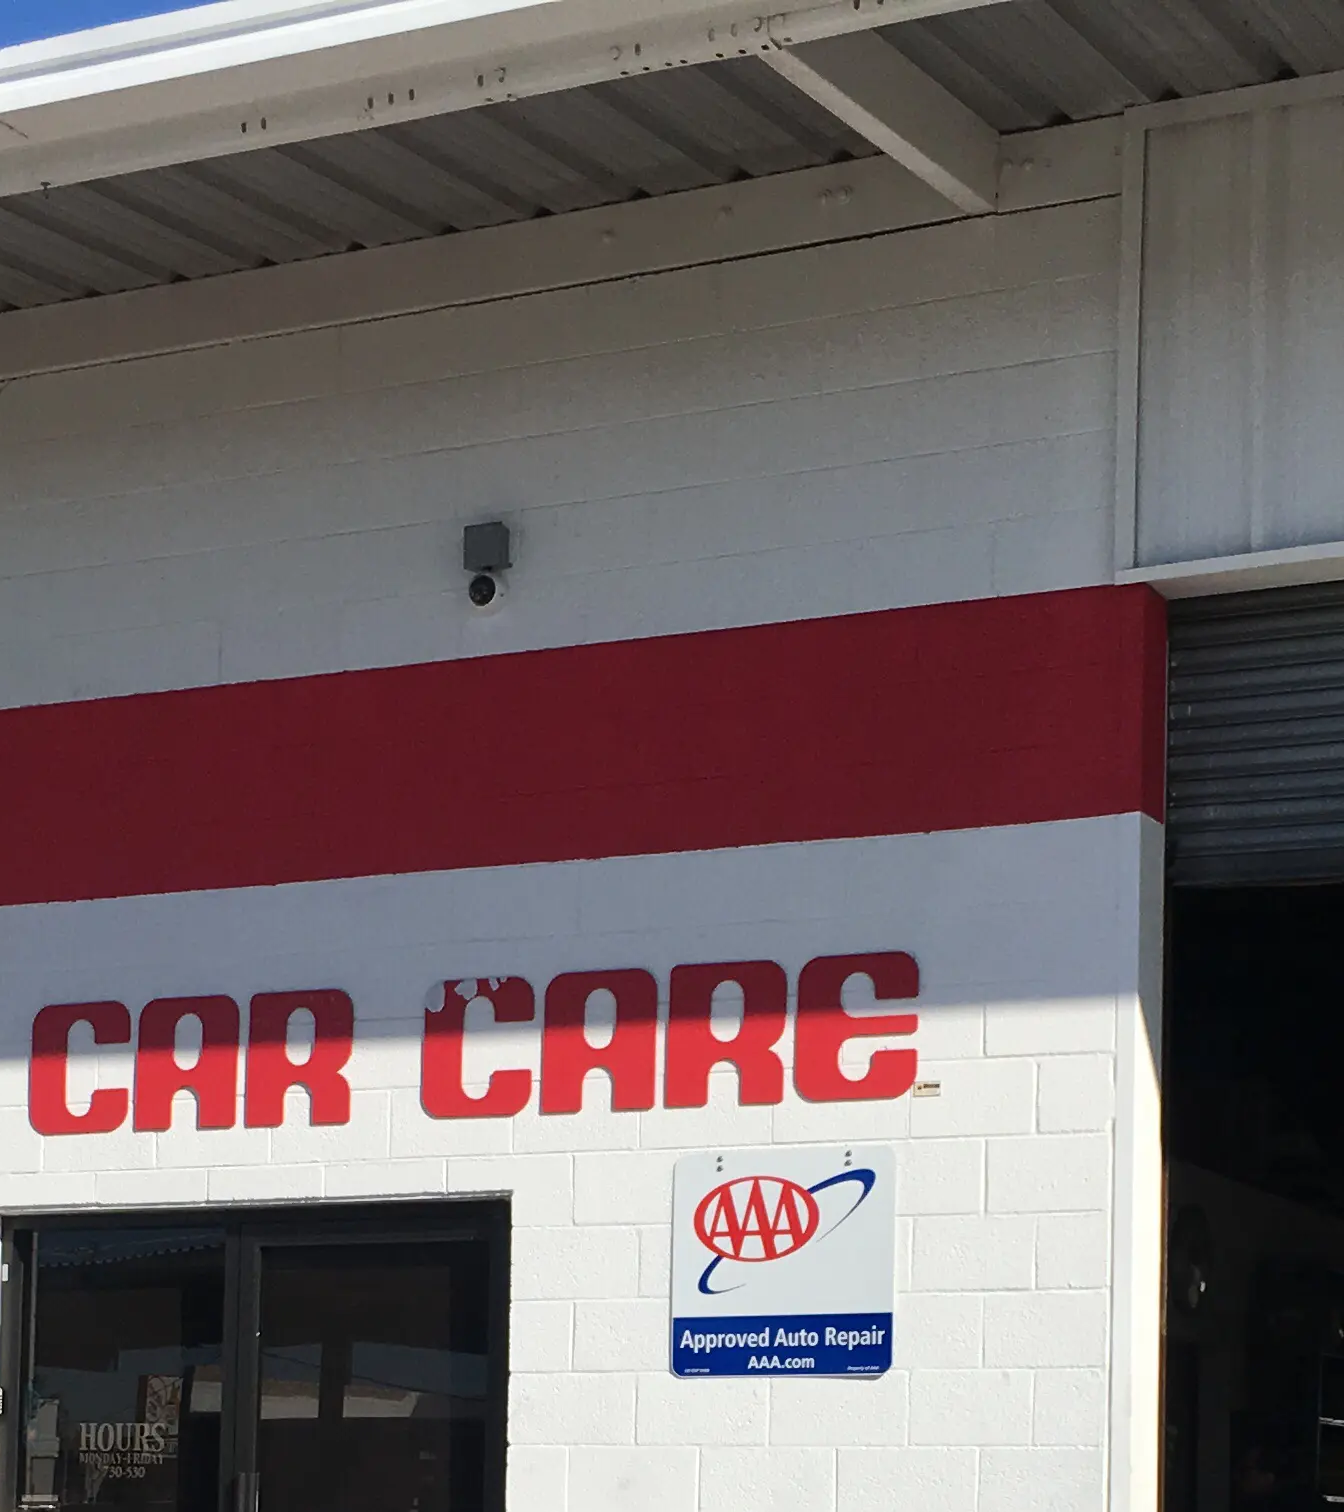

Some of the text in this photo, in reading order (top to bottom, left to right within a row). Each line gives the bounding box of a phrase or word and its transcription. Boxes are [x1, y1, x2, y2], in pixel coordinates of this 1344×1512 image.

[28, 988, 354, 1136] CAR
[420, 950, 920, 1120] CARE
[702, 1177, 812, 1261] AAA
[679, 1324, 886, 1354] Approved Auto Repair
[747, 1354, 815, 1369] AAA.com
[79, 1422, 165, 1452] HOURS
[79, 1452, 163, 1465] MONDAY-FRIDAY
